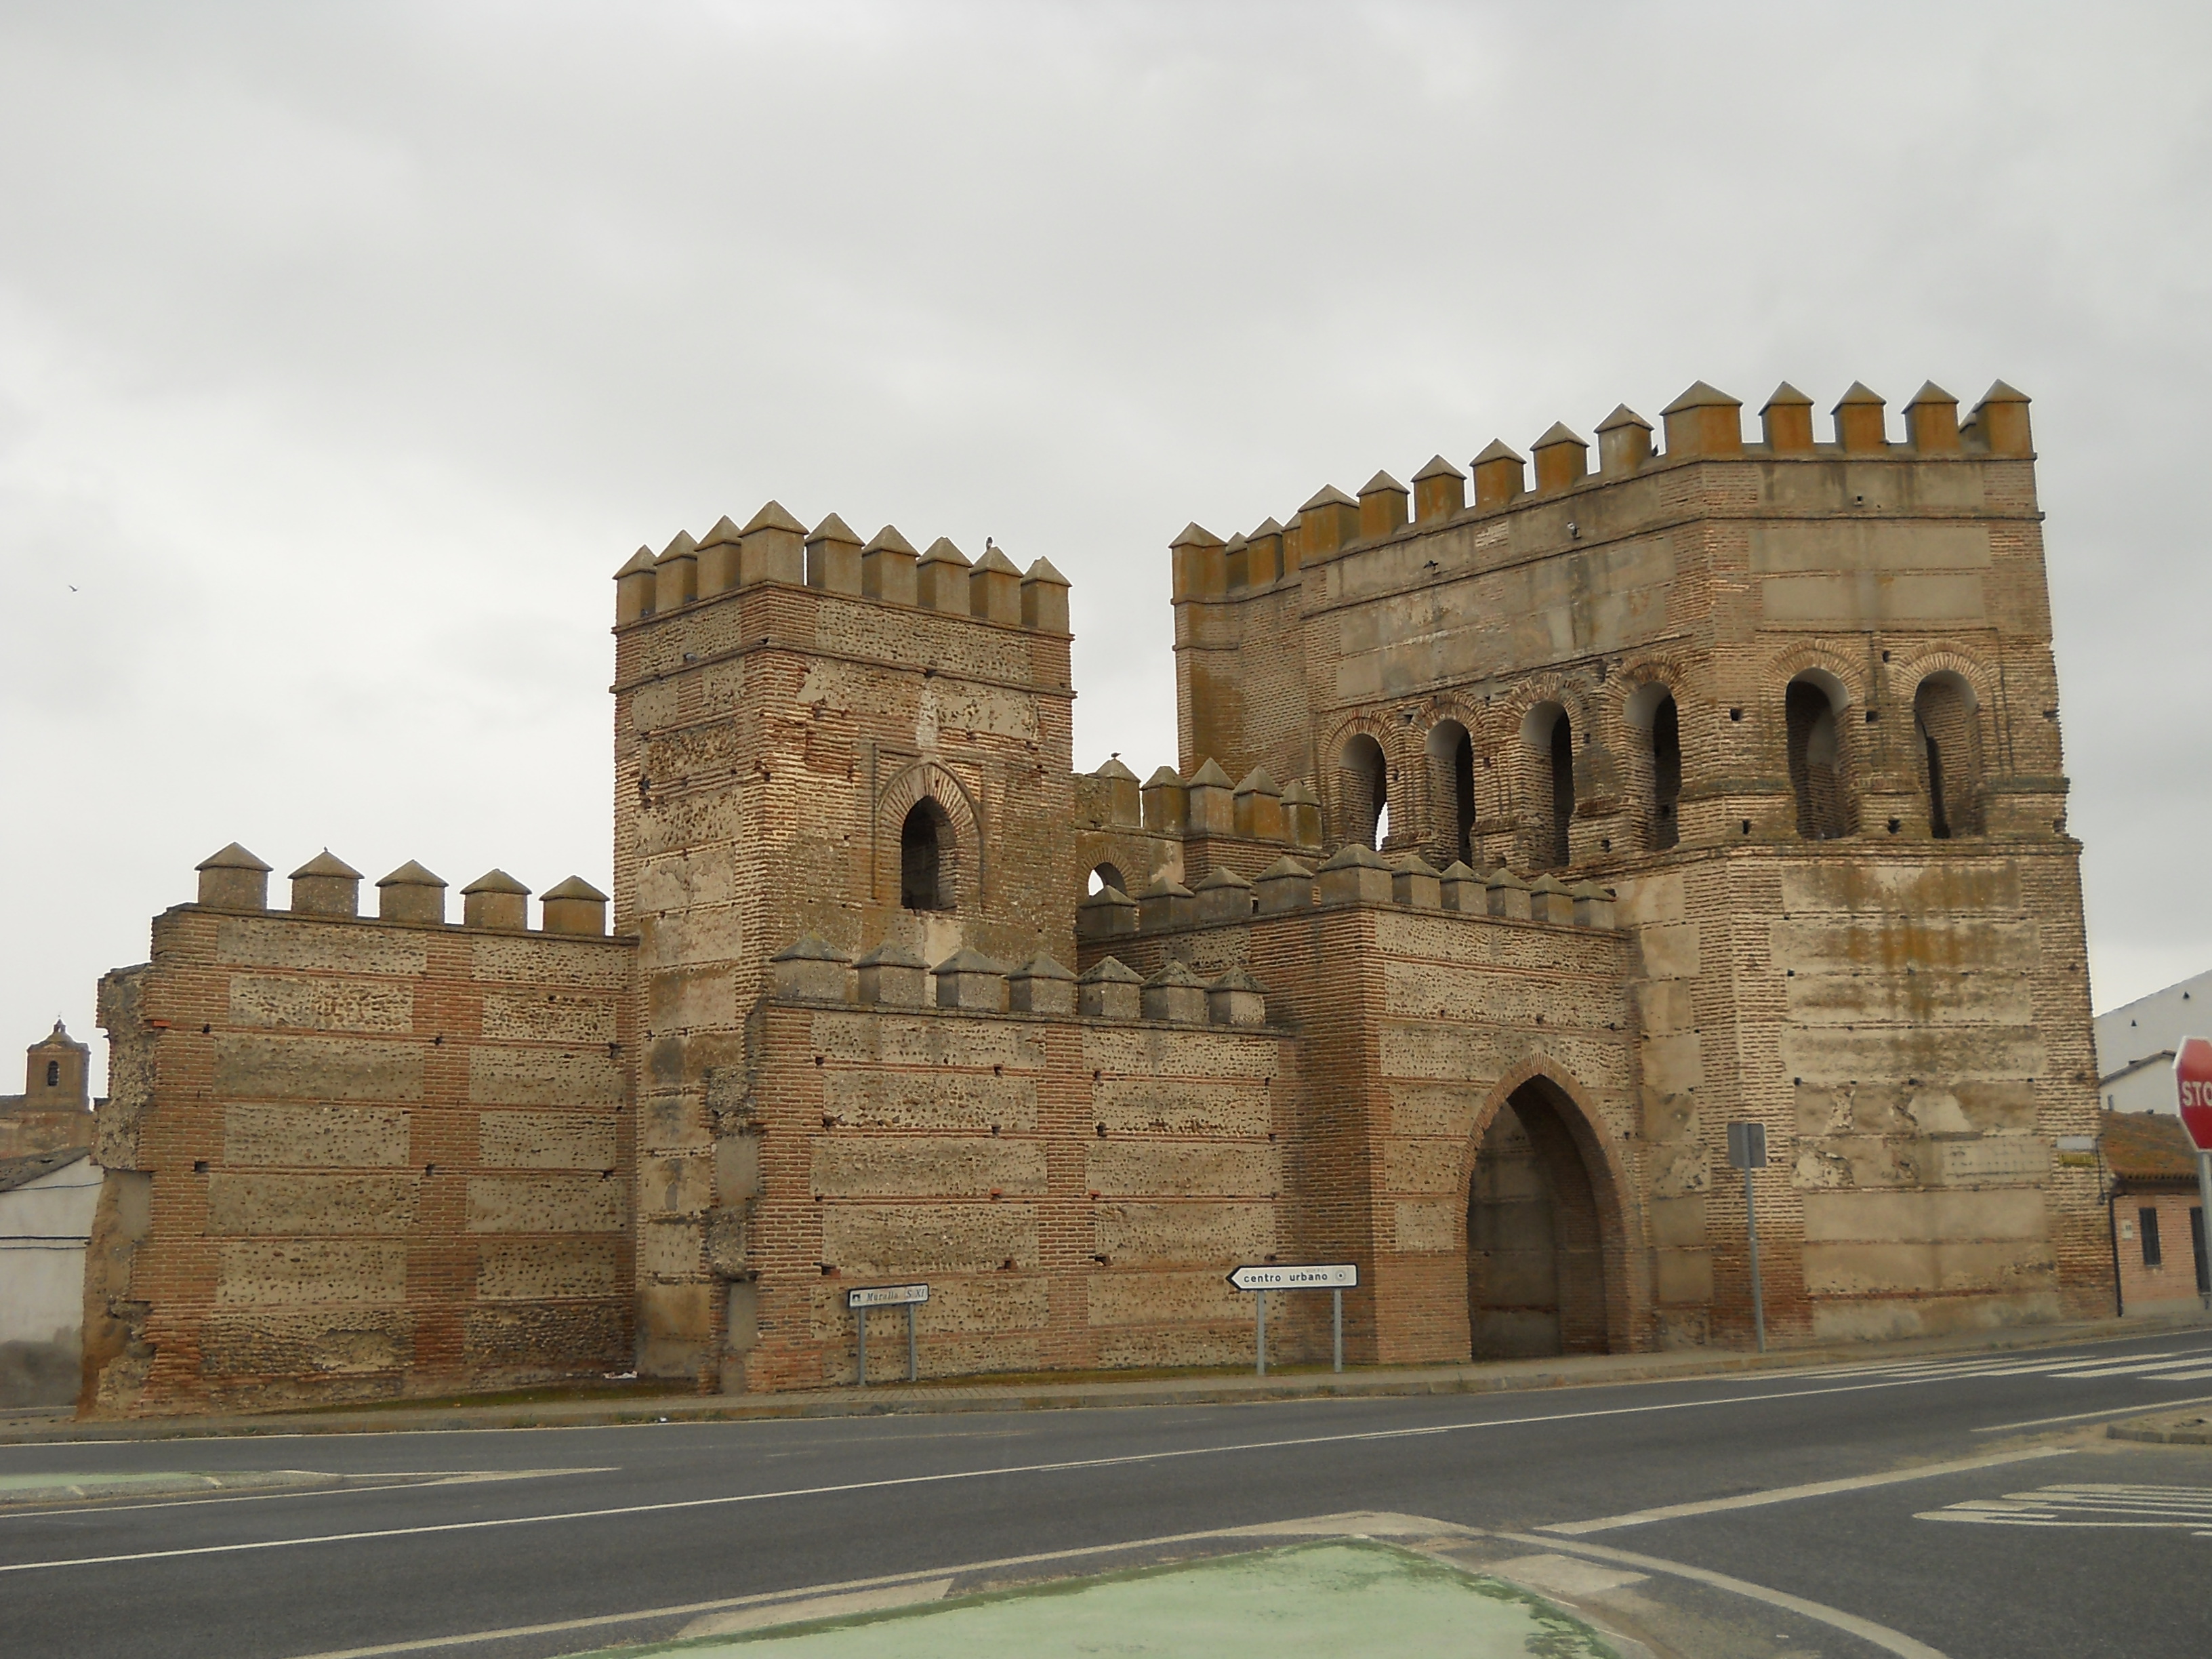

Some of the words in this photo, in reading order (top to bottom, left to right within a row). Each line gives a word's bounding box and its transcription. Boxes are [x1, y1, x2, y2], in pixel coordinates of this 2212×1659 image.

[1244, 1273, 1281, 1283] centro
[1289, 1272, 1328, 1282] urbano
[867, 1291, 899, 1301] Muralla
[906, 1290, 912, 1298] S
[916, 1288, 925, 1298] XI
